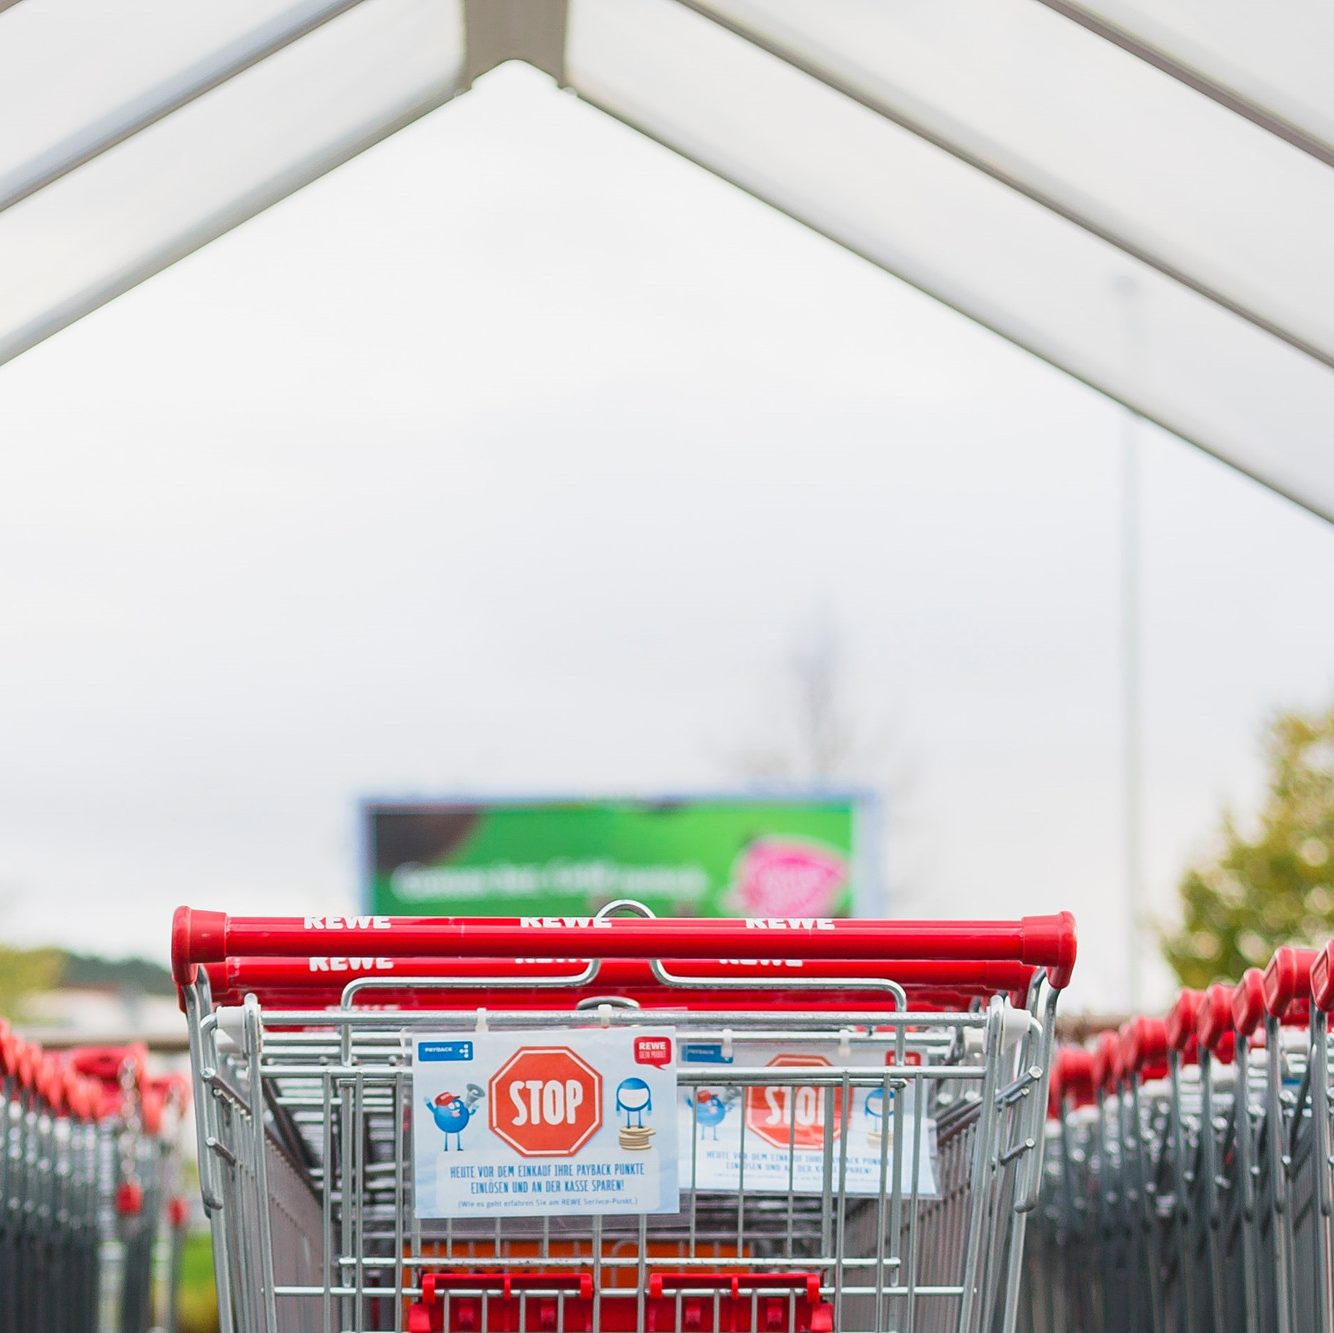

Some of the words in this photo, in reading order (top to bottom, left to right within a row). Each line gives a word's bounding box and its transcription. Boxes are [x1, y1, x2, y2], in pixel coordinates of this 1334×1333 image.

[638, 1041, 666, 1050] REWE
[509, 1080, 583, 1126] STOP
[450, 1166, 475, 1178] HEUTE
[478, 1166, 494, 1178] VOR
[498, 1165, 514, 1177] DEM
[518, 1165, 551, 1177] EINKAUF
[554, 1164, 573, 1176] IHRE
[577, 1164, 611, 1176] PAYBACK
[615, 1163, 645, 1175] PUNKTE
[471, 1180, 508, 1194] EINLÖSEN
[512, 1181, 528, 1193] UND
[532, 1181, 542, 1193] AN
[545, 1181, 561, 1192] DER
[565, 1180, 588, 1192] KASSE
[592, 1179, 624, 1191] SPAREN!
[458, 1200, 474, 1208] (Wie
[487, 1200, 501, 1208] geht
[504, 1199, 534, 1207] erfahren
